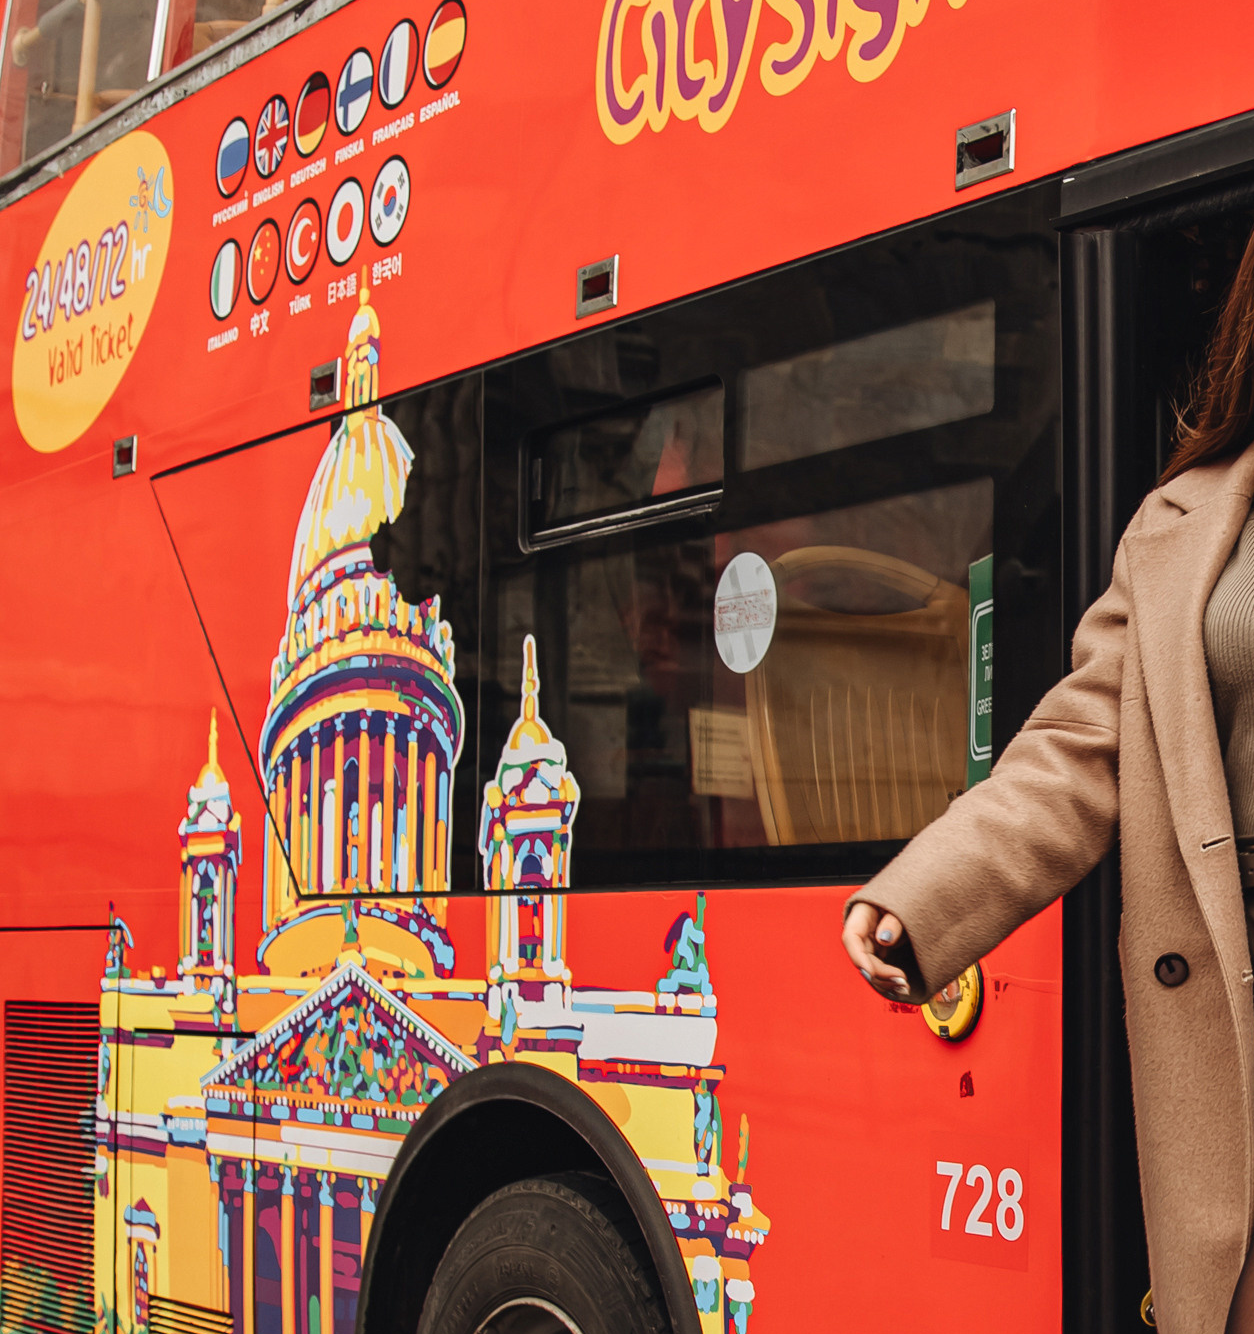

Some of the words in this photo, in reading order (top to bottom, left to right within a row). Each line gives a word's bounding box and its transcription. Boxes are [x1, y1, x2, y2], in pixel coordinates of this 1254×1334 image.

[419, 91, 461, 123] ESPAÑOL
[372, 113, 415, 146] FRANÇAIS
[334, 139, 365, 165] FINSKA
[290, 157, 327, 188] DEUTSCH
[212, 190, 248, 227] РУССКИЙ
[252, 179, 284, 207] ENGLISH
[22, 219, 129, 341] 24/48/72
[131, 238, 152, 285] hr
[372, 252, 402, 286] 한국어
[289, 294, 311, 315] TÜRK
[327, 272, 357, 305] 日本語
[250, 308, 270, 337] 中文
[48, 331, 84, 388] Valid
[91, 312, 134, 367] Ticket
[207, 326, 239, 352] ITALIANO
[936, 1160, 1025, 1242] 728
